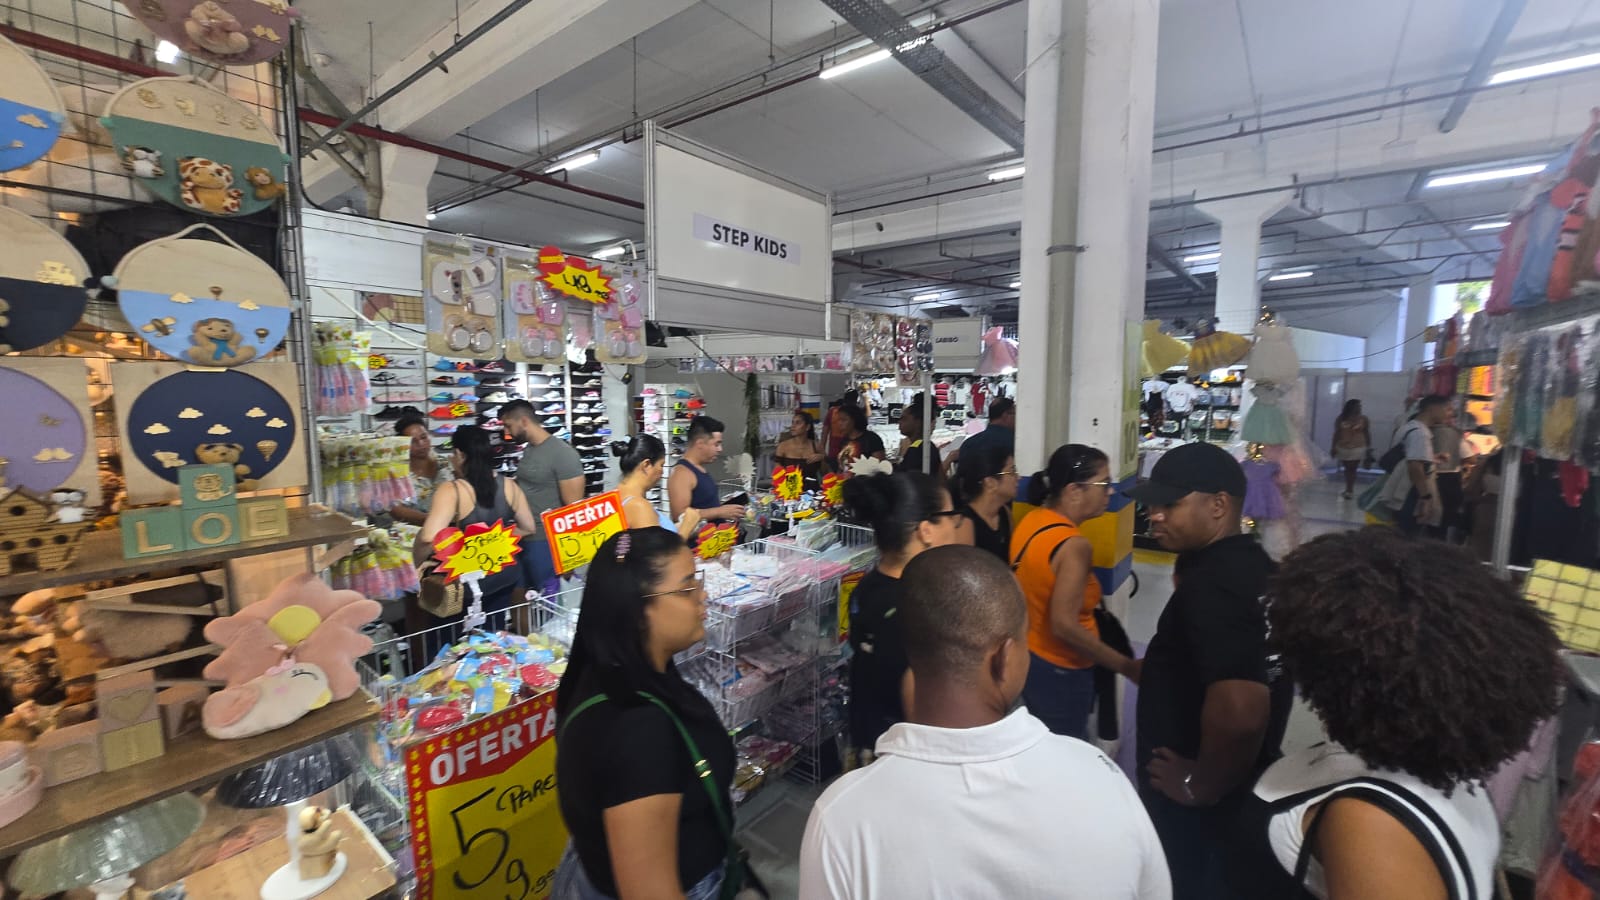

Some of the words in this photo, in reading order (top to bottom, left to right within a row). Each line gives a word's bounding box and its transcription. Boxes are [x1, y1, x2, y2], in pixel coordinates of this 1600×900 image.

[712, 223, 749, 248] STEP
[754, 235, 787, 259] KIDS
[553, 501, 616, 533] OFERTA
[462, 539, 478, 560] 5
[429, 707, 557, 786] OFERTA
[450, 786, 510, 890] 5
[496, 773, 557, 814] PARE
